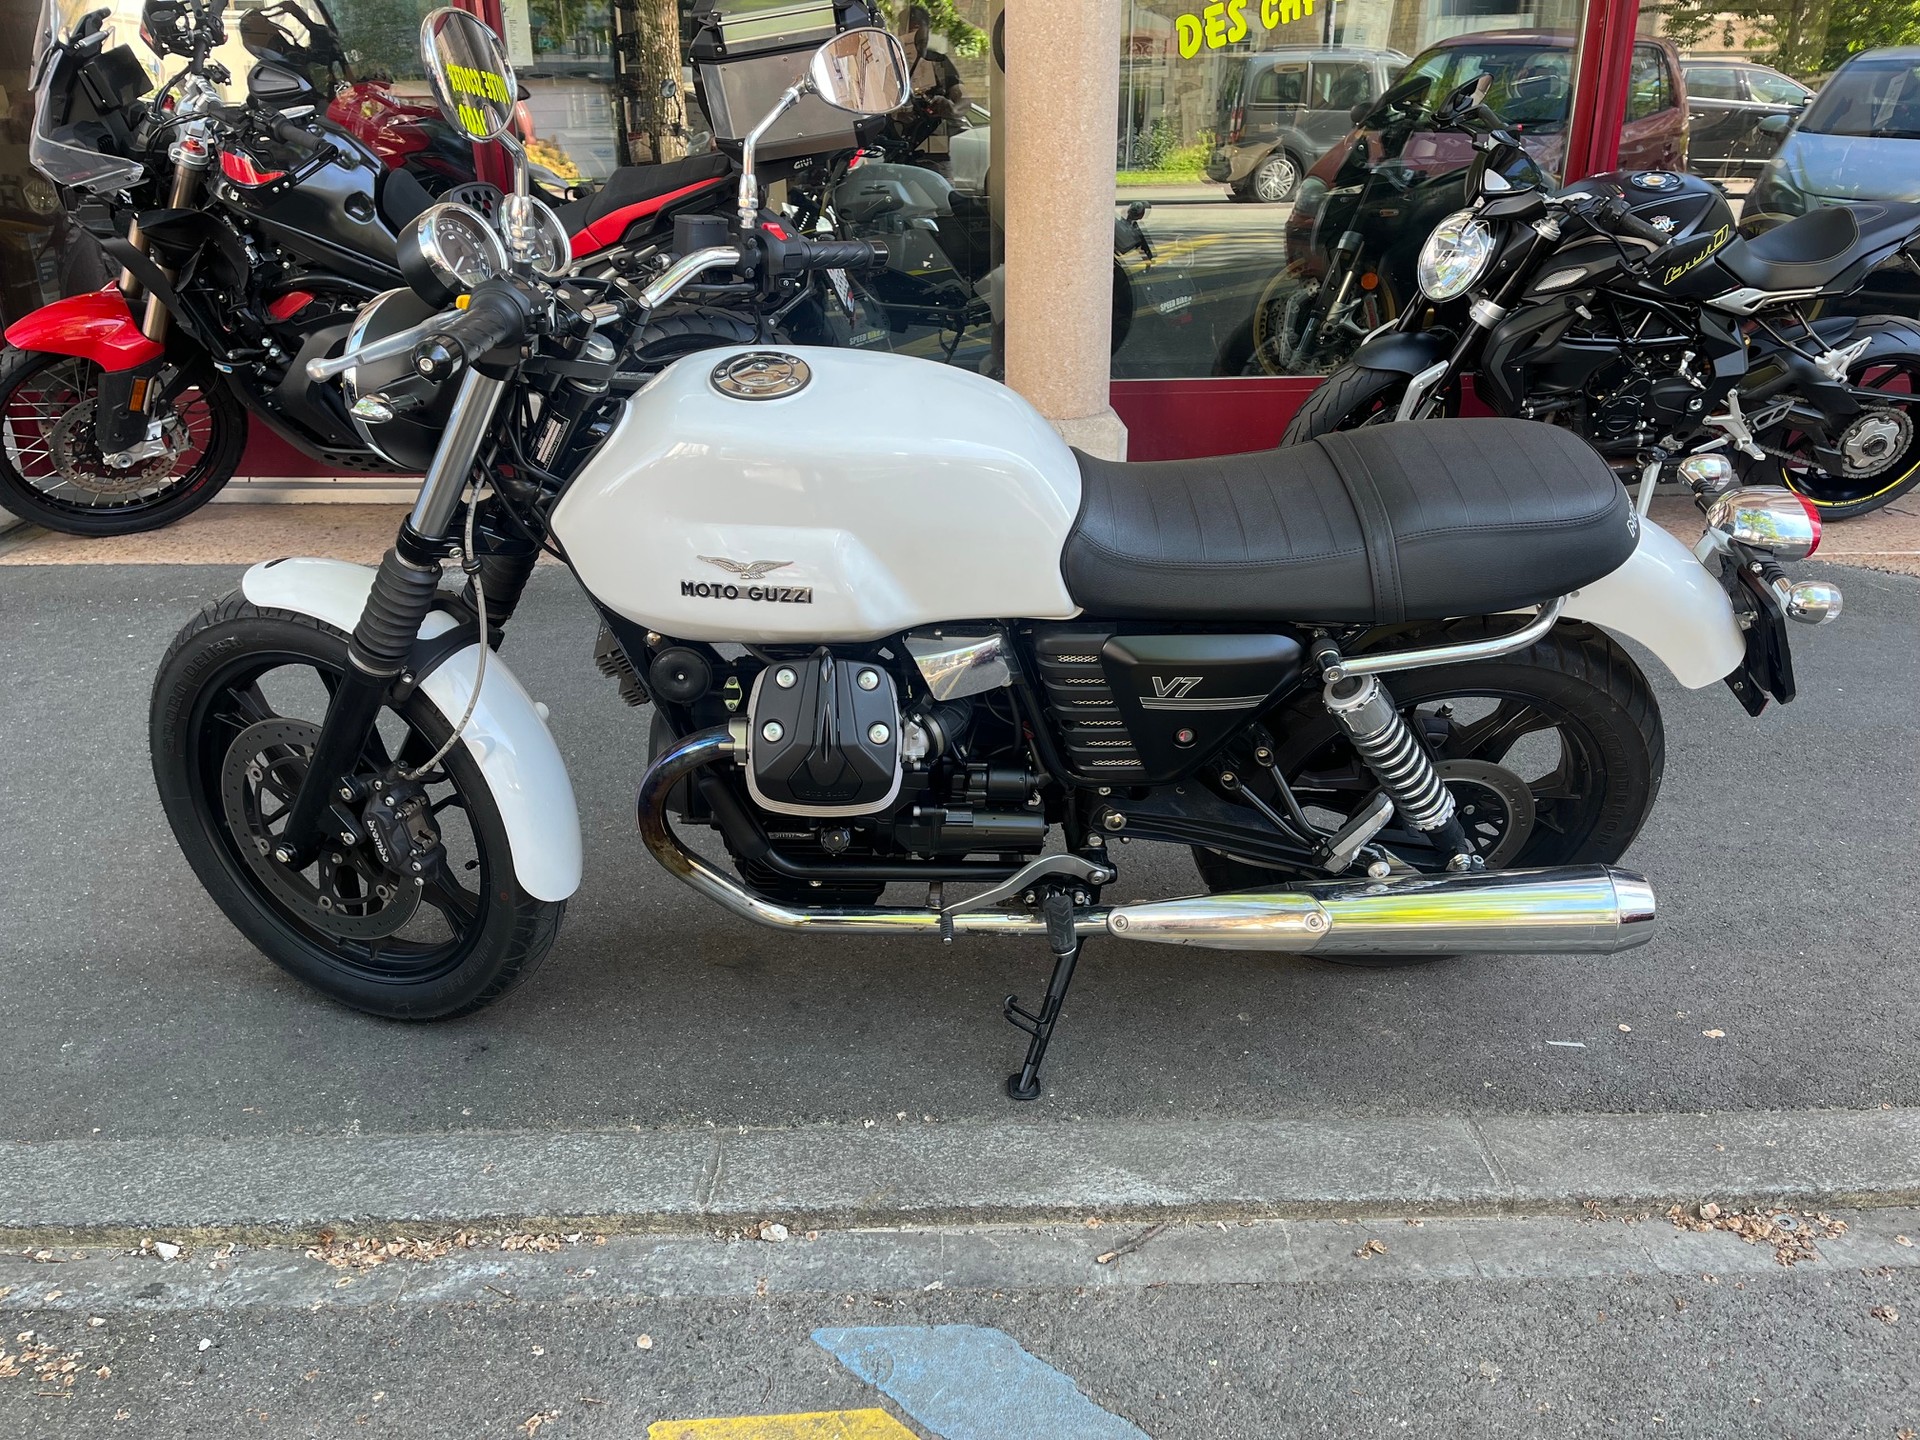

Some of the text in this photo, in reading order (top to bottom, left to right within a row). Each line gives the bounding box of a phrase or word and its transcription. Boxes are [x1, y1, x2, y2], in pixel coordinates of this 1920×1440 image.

[680, 580, 812, 604] MOTO GUZZI
[1151, 676, 1204, 698] V7
[366, 820, 389, 863] brembo
